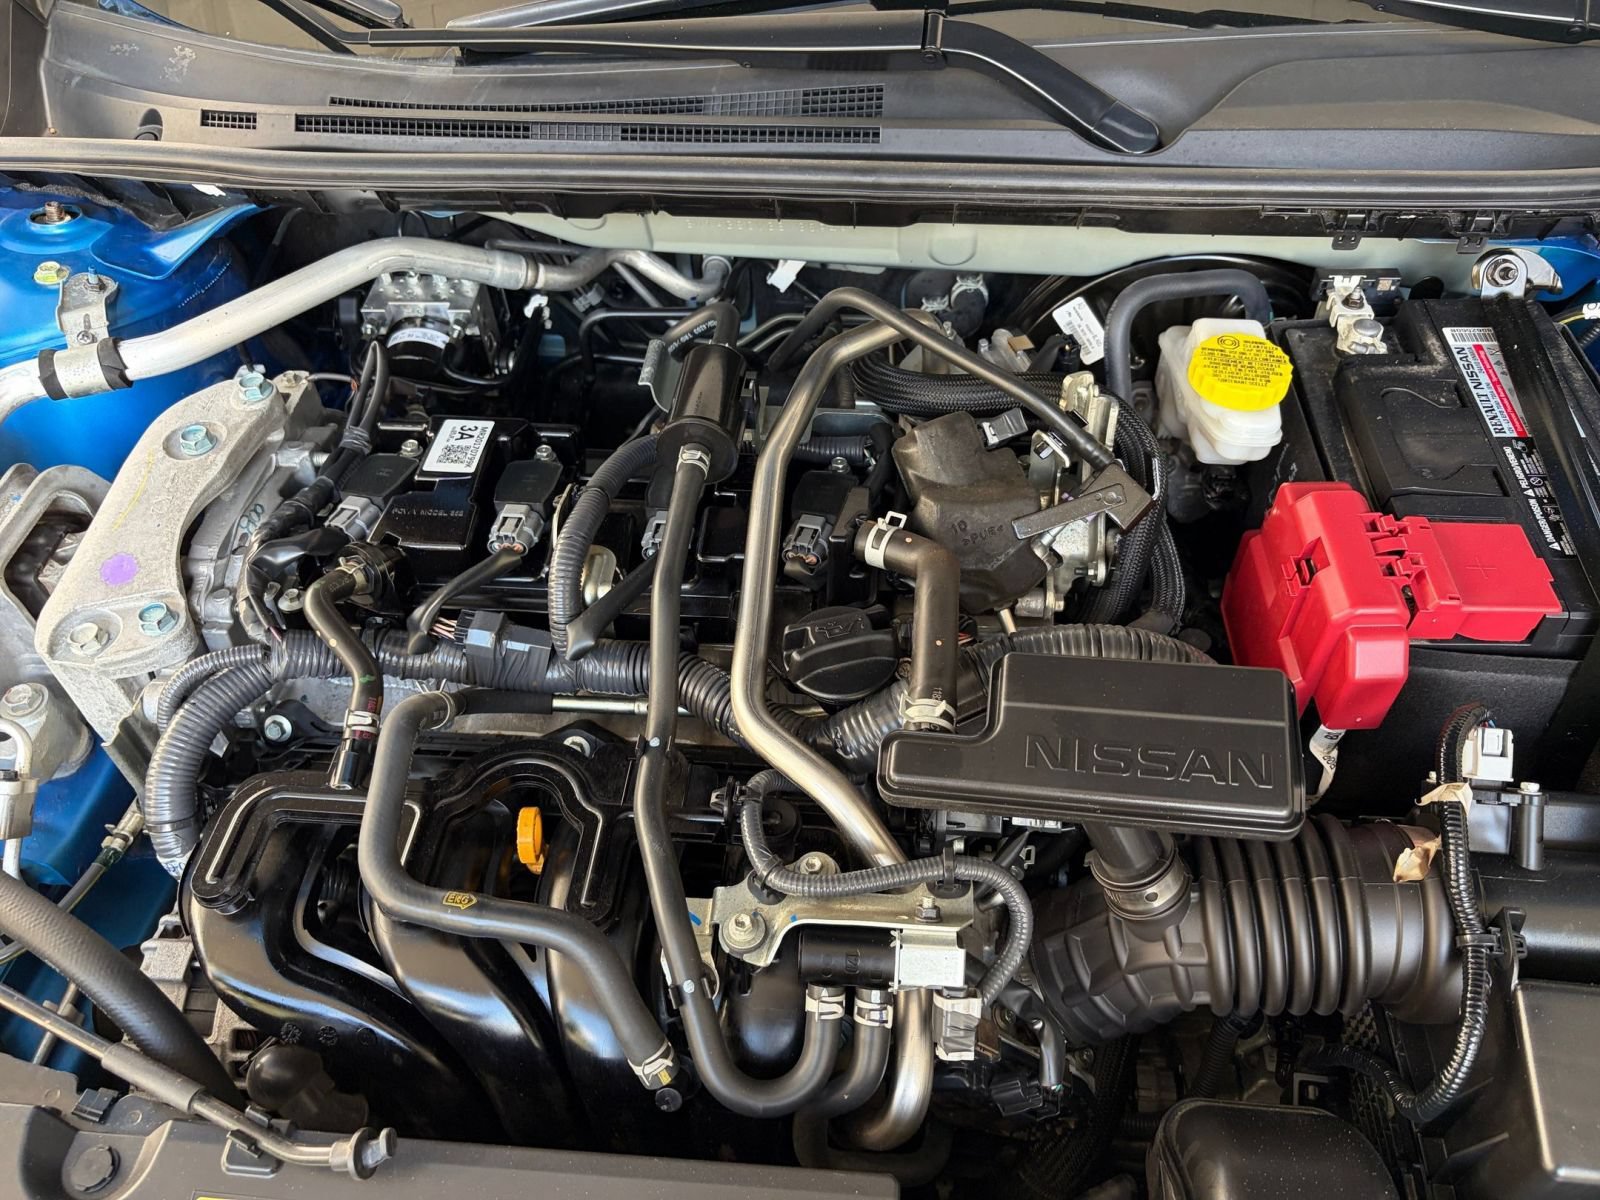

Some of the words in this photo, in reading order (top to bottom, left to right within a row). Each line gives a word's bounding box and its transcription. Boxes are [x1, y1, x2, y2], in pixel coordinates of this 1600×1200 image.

[1454, 347, 1484, 390] NISSAN
[455, 425, 478, 441] 3A
[1476, 393, 1506, 434] RENAULT
[1025, 735, 1273, 789] NISSAN
[447, 893, 470, 904] ENG
